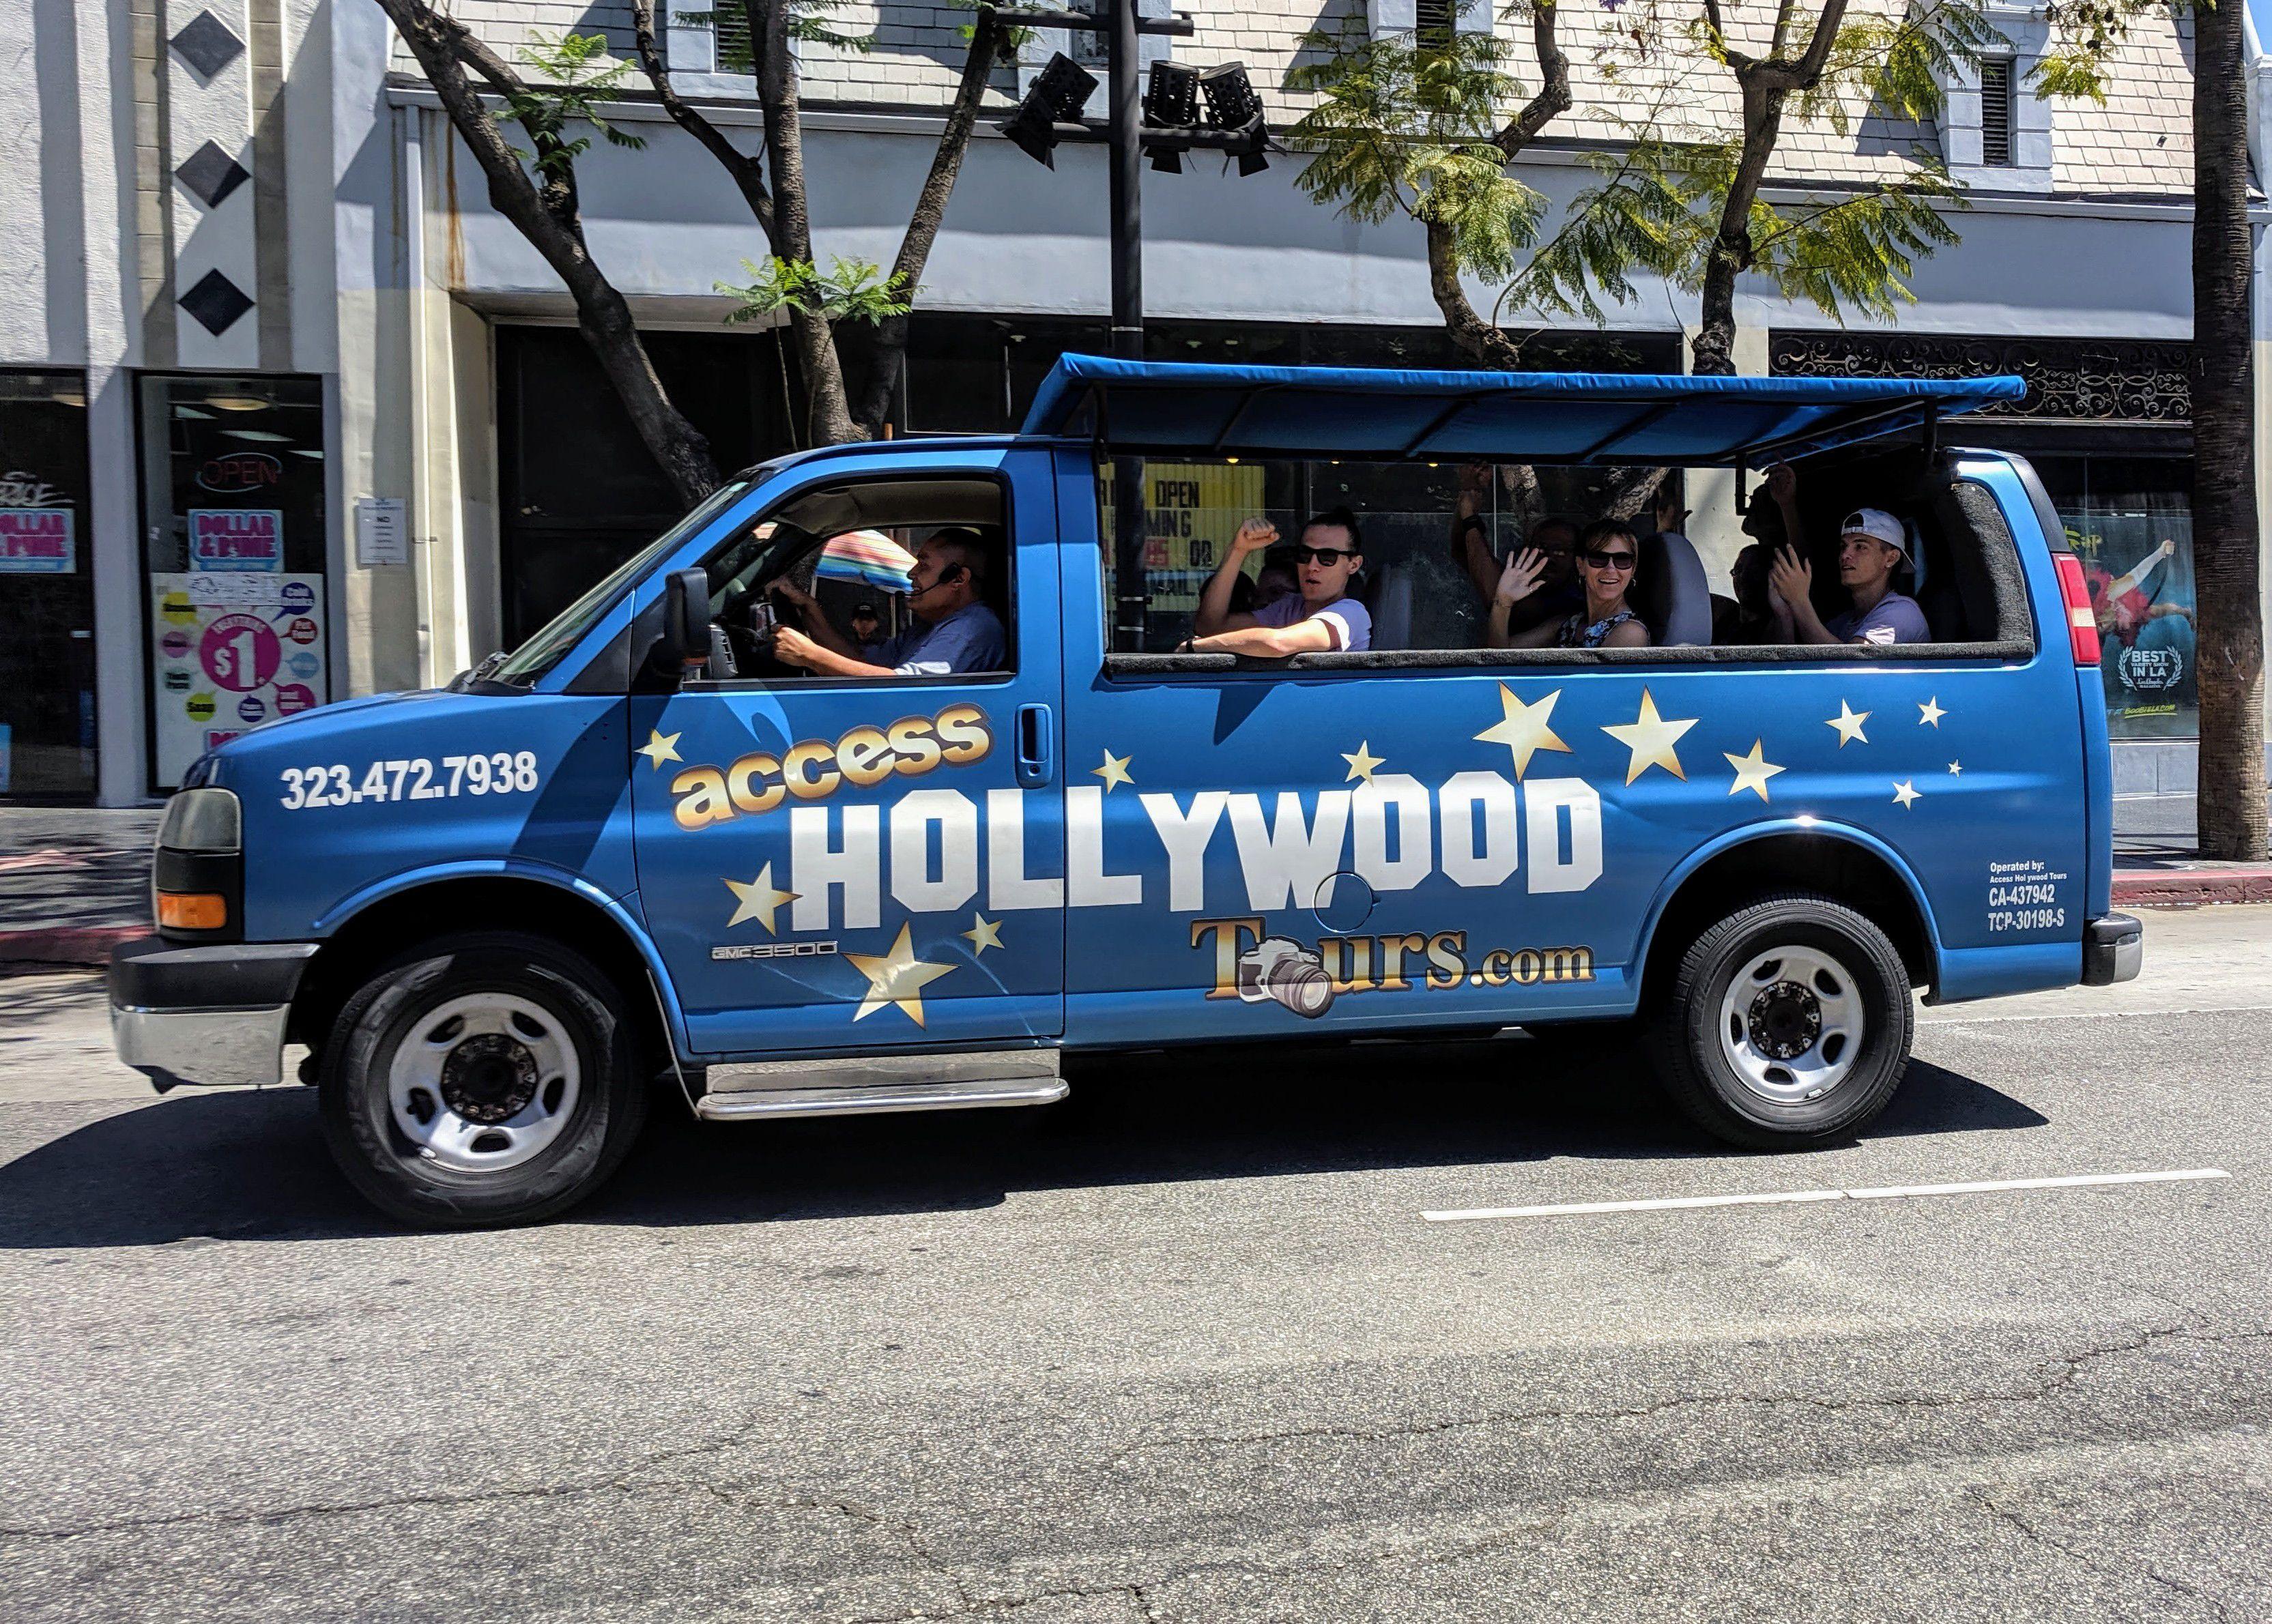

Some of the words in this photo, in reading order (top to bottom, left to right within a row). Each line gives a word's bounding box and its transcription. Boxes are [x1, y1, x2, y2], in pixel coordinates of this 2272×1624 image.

[204, 460, 278, 485] OPEN
[1155, 480, 1200, 508] OPEN
[0, 514, 66, 535] OLLAR
[199, 515, 275, 536] DOLLAR
[2131, 650, 2169, 663] BEST
[2133, 667, 2146, 677] IN
[2149, 667, 2167, 677] LA
[670, 703, 994, 832] access
[281, 751, 539, 810] 323.472.7938
[790, 770, 1603, 932] HOLLYWOOD
[1989, 875, 2013, 884] Access
[2050, 872, 2067, 880] Tours
[1990, 860, 2030, 874] Operated
[2032, 860, 2045, 872] by:
[1989, 884, 2055, 907] CA-437942
[1987, 908, 2065, 931] TCP-30198-S
[1190, 916, 1597, 1002] Turs.com
